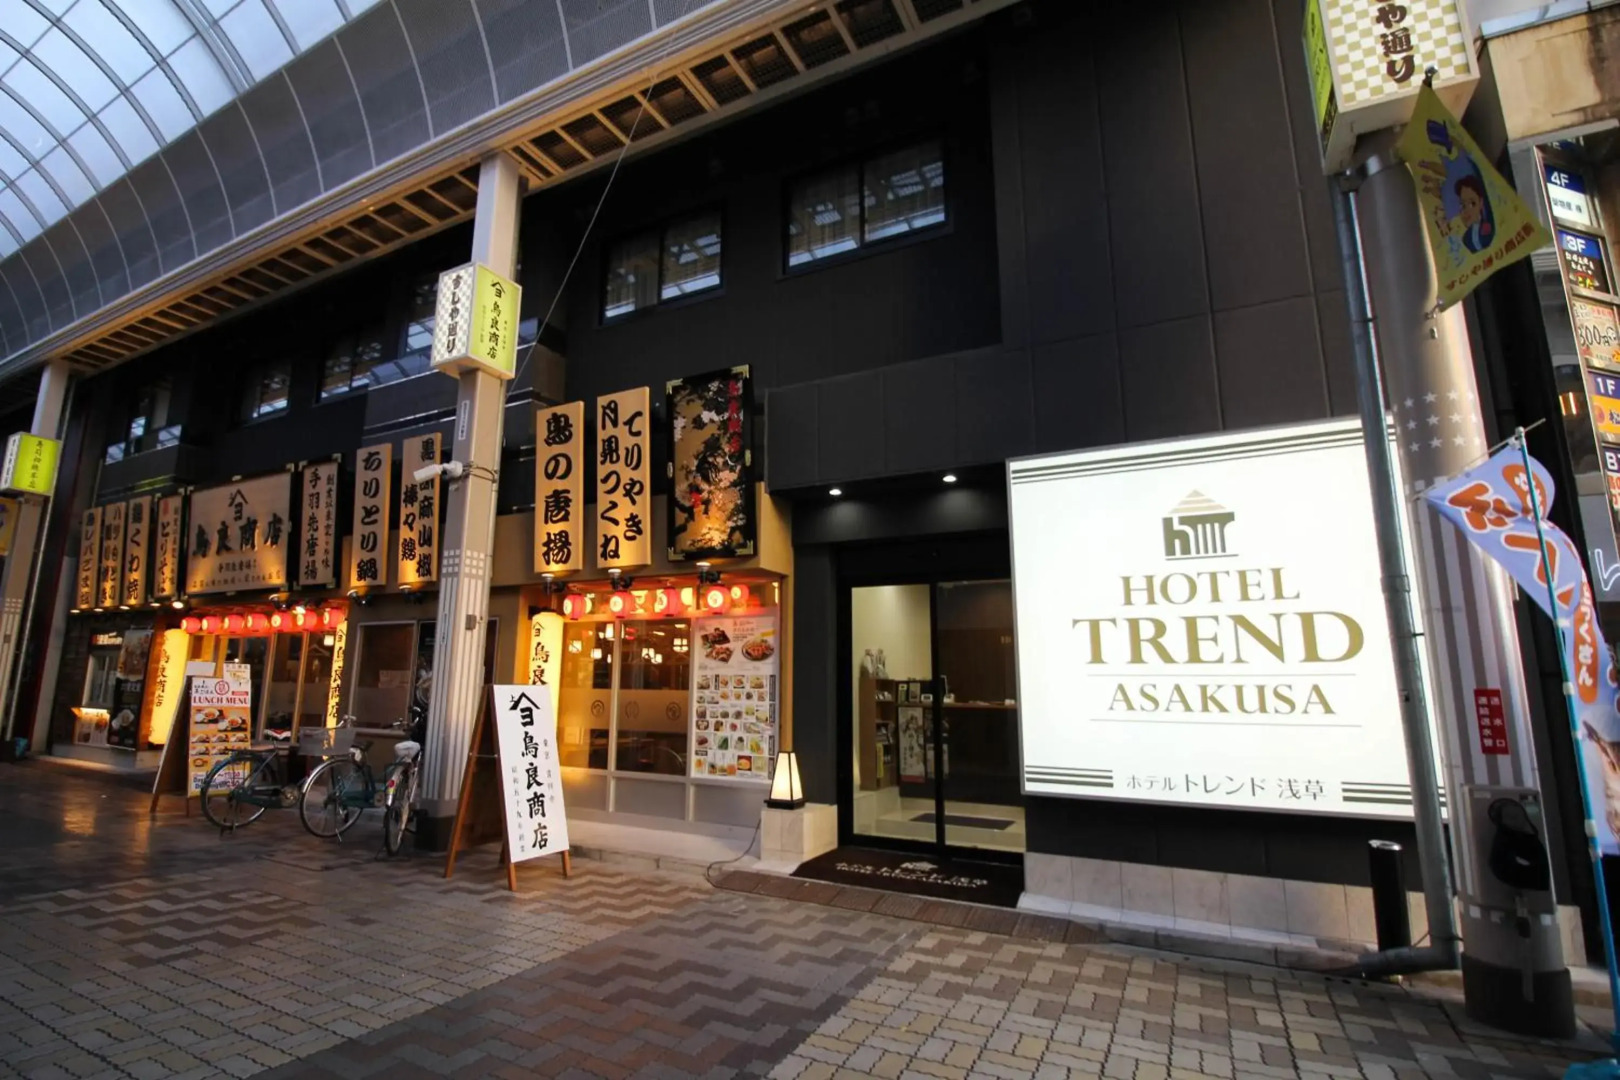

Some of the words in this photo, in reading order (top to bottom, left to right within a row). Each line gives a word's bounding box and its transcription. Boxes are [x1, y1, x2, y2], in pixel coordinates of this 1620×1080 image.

[1376, 0, 1415, 83] や通り
[1551, 171, 1569, 187] 4F
[1566, 235, 1586, 253] 3F
[447, 274, 462, 353] すしや通り
[486, 301, 502, 360] 鳥良商店
[1595, 377, 1615, 396] 1F
[600, 400, 621, 561] 月見つくね
[622, 411, 644, 541] てりやき
[304, 468, 321, 580] 手羽先唐揚
[357, 451, 382, 582] ちりとり鍋
[1120, 567, 1300, 606] HOTEL
[1072, 611, 1364, 665] TREND
[193, 696, 224, 704] LUNCH
[225, 696, 249, 705] MENU
[1108, 683, 1336, 715] ASAKUSA
[1490, 696, 1506, 747] 送水口
[521, 731, 549, 850] 鳥良商店
[1277, 778, 1326, 800] 浅草
